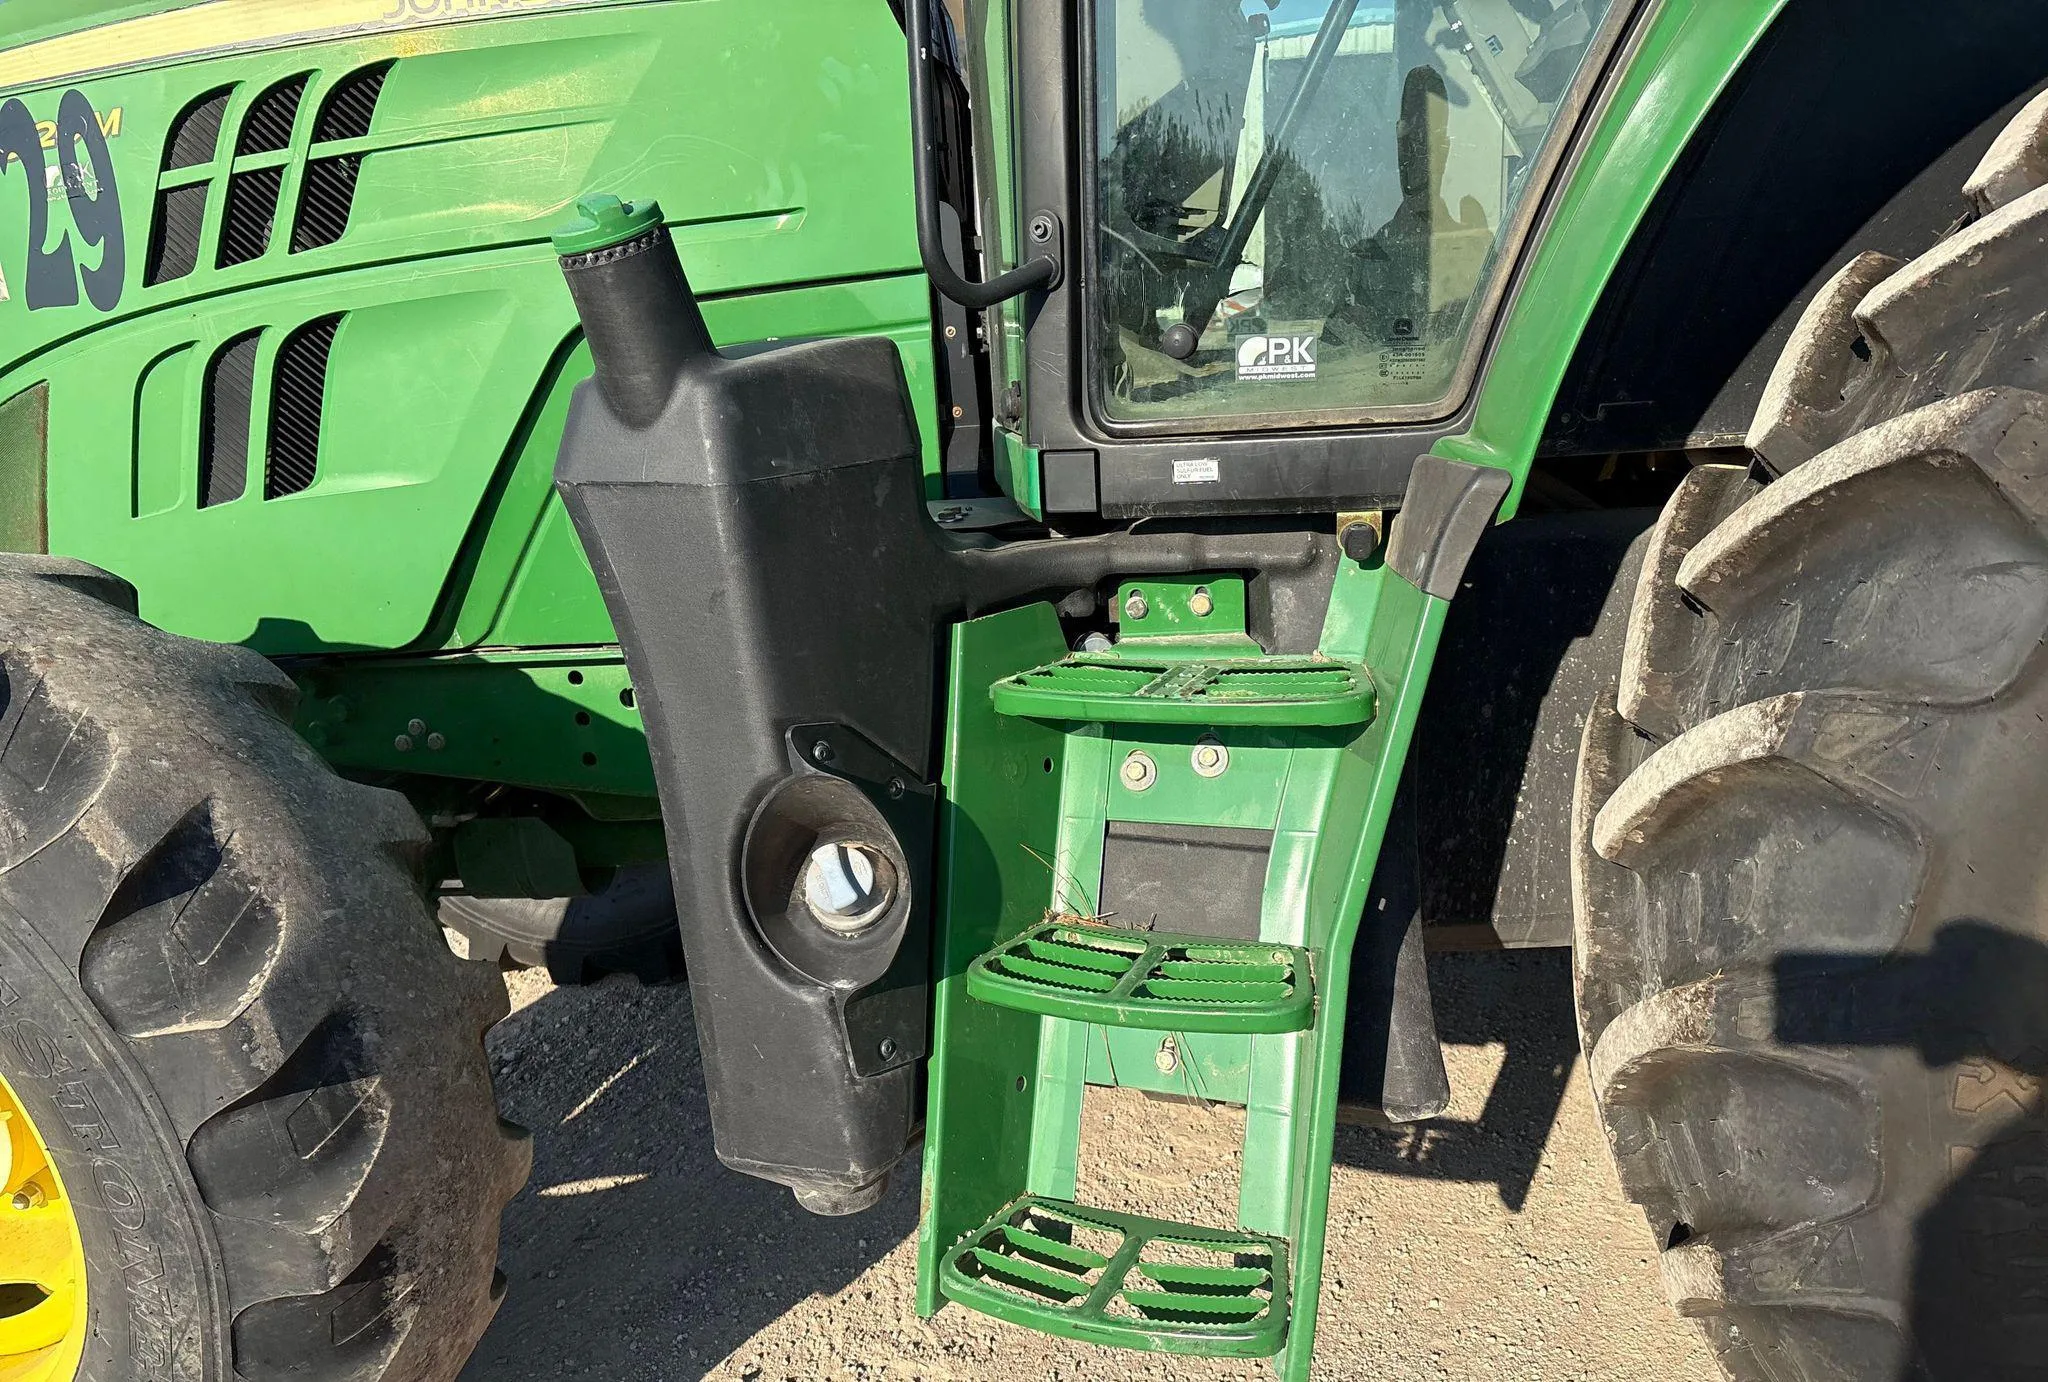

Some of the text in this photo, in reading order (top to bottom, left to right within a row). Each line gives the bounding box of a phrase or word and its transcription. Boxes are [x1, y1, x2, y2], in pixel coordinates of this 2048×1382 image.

[1268, 336, 1314, 364] P&K
[1246, 365, 1306, 373] MIDWEST
[1238, 372, 1316, 381] www.pkmidwest.com
